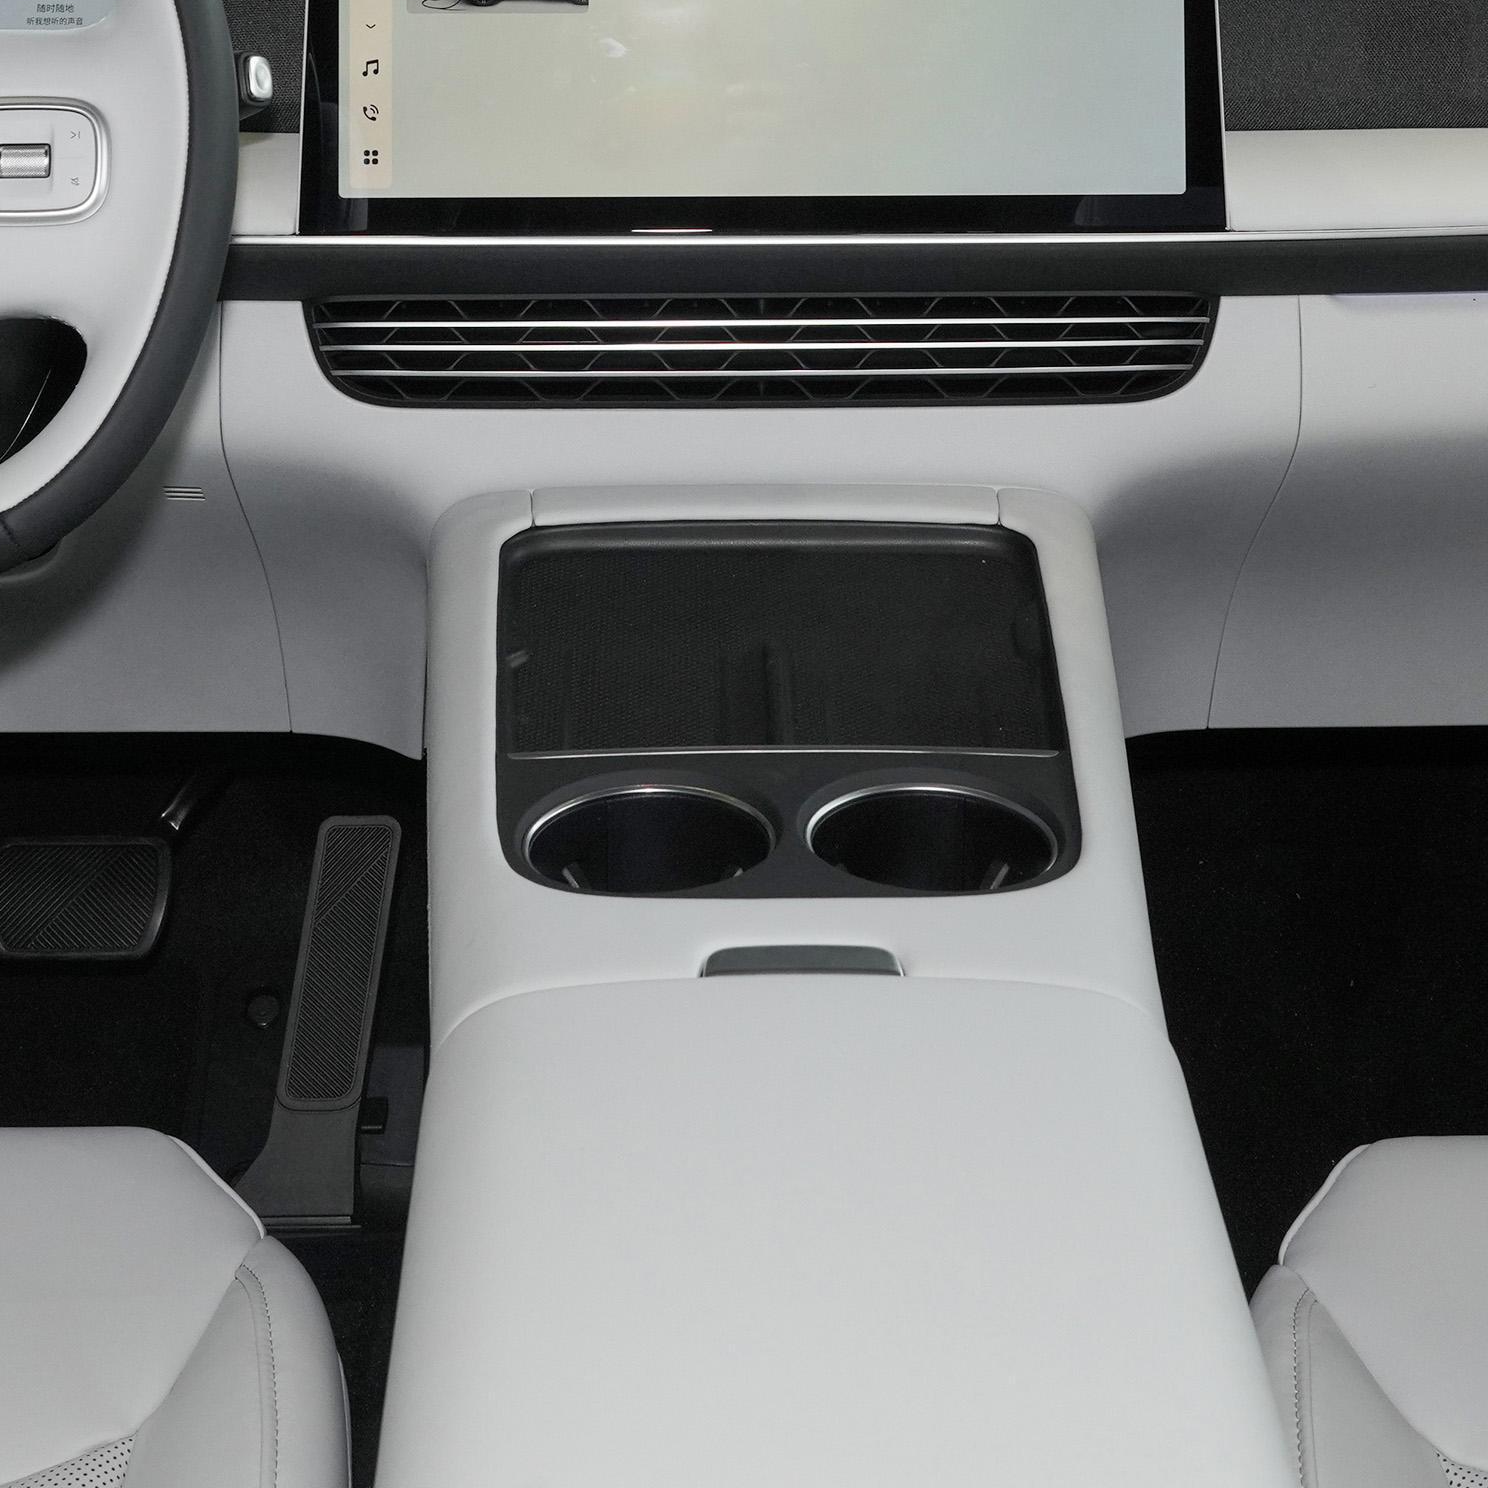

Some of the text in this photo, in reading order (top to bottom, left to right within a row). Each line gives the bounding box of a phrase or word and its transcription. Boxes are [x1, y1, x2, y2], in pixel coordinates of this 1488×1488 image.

[36, 3, 75, 14] 随时随地
[25, 16, 83, 26] 听我想听的声音
